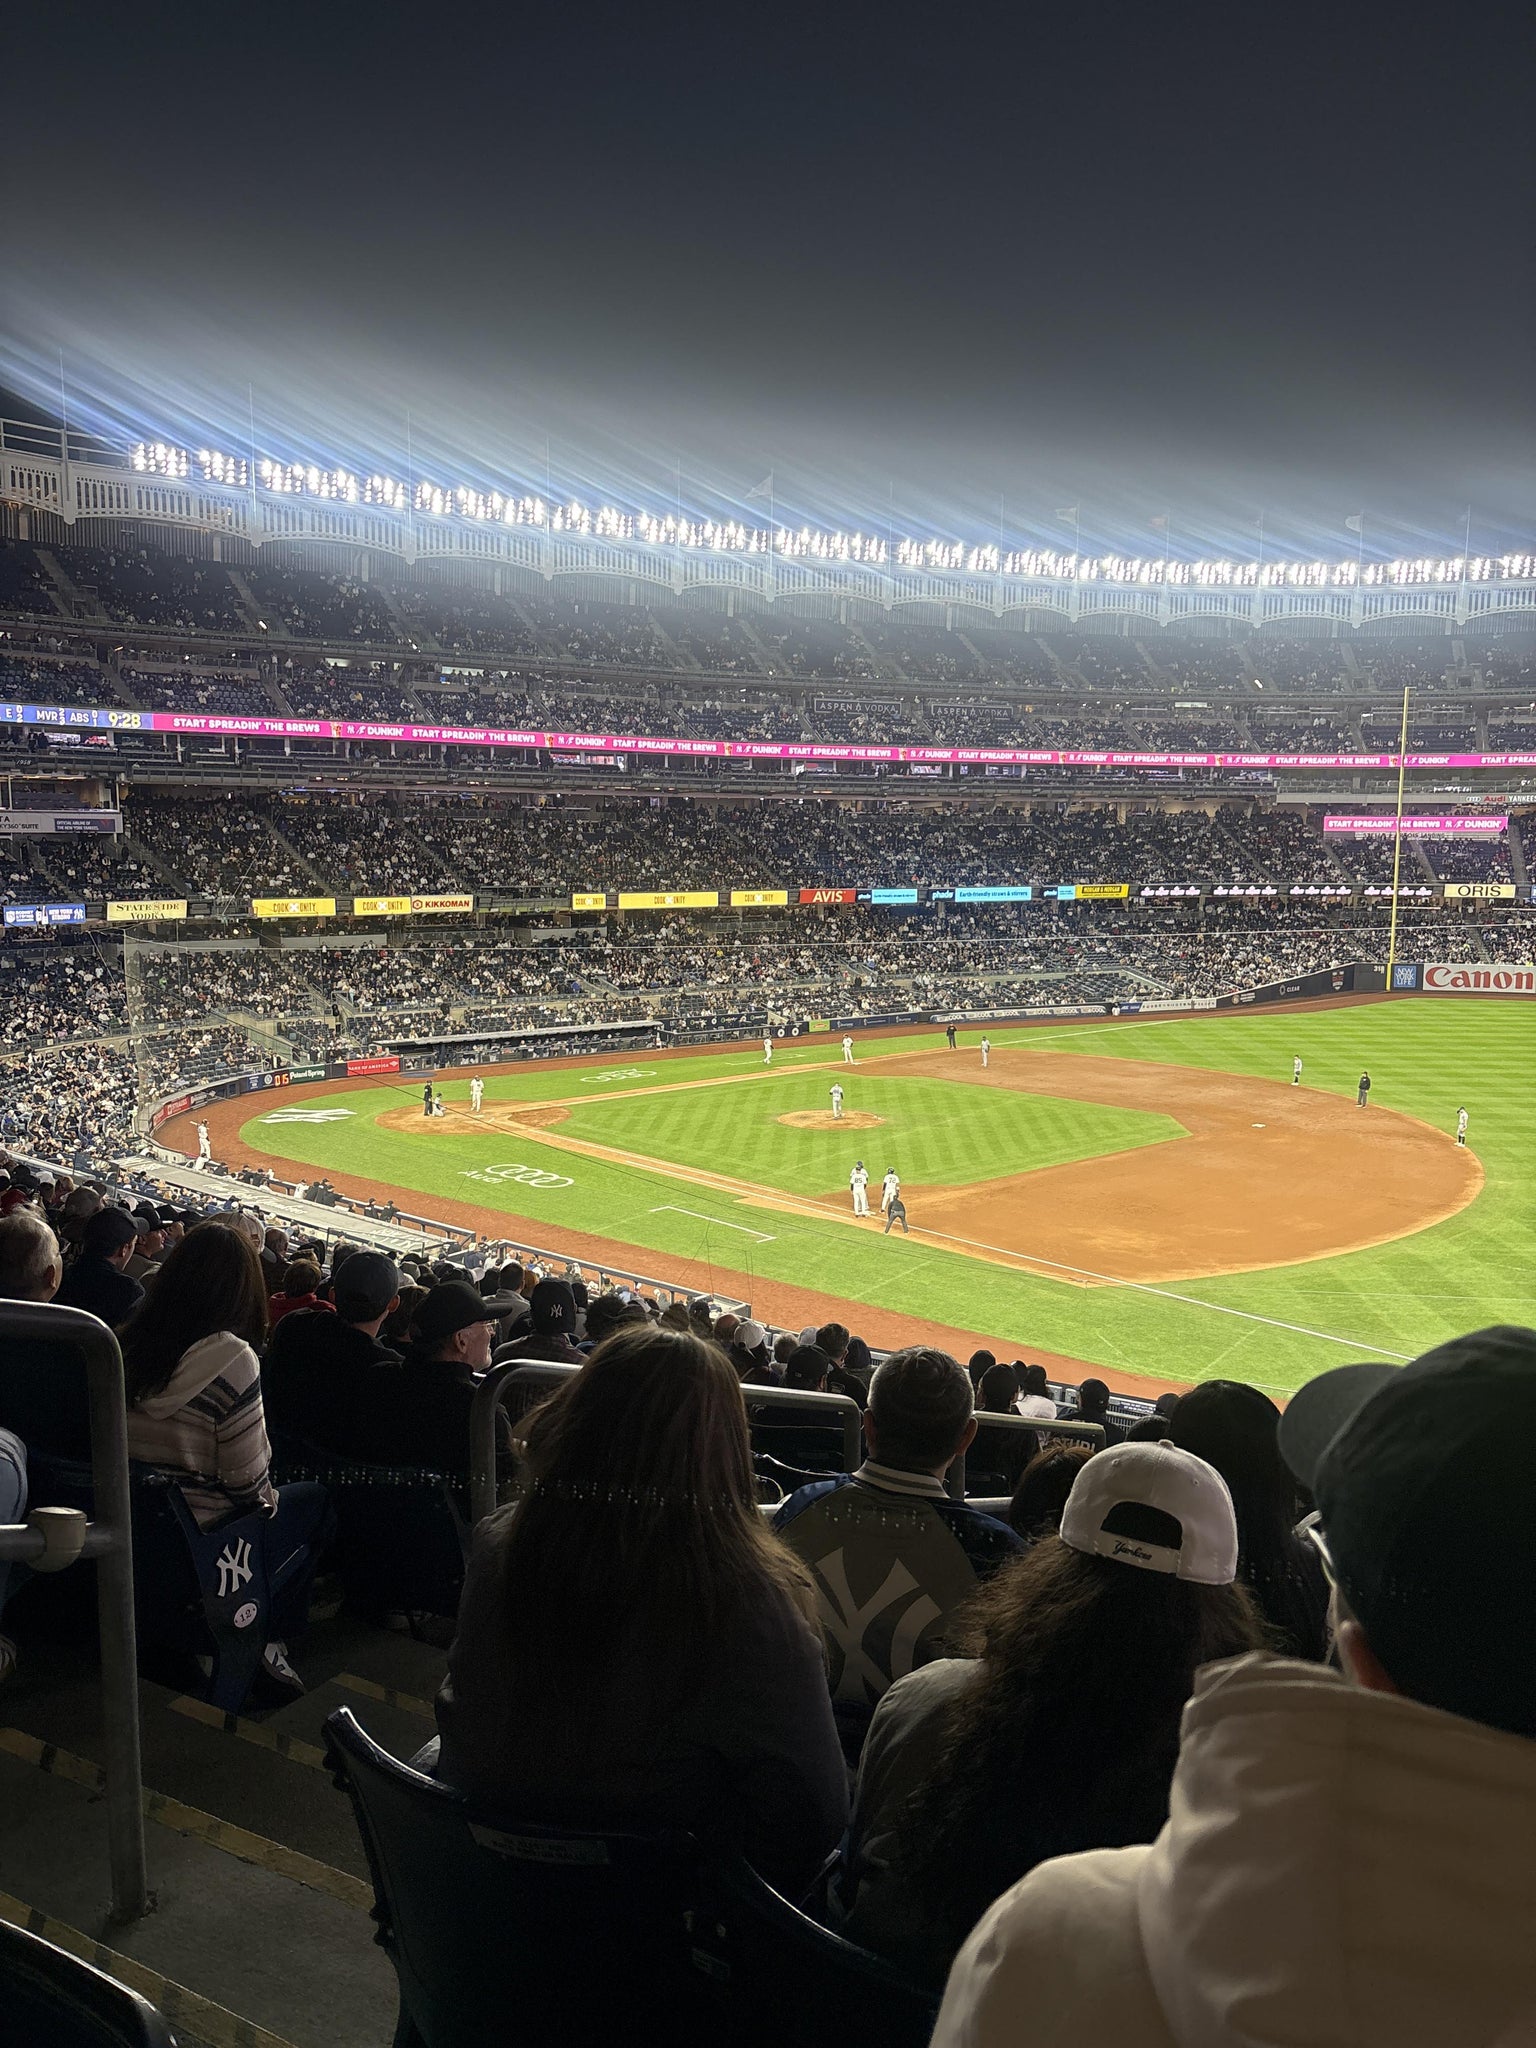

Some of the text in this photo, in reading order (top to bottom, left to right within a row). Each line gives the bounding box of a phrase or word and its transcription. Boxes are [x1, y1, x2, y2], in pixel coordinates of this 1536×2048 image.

[820, 703, 897, 713] ASPEN VODKA
[6, 708, 13, 718] E
[16, 705, 23, 714] 0
[36, 710, 58, 721] MVR
[59, 708, 65, 717] 2
[70, 712, 89, 723] ABS
[108, 712, 142, 728] 9:28
[16, 713, 23, 723] 2
[173, 718, 320, 733] START SPREADIN' THE BREWS
[367, 726, 404, 736] DUNKIN'
[412, 728, 440, 739] START
[441, 729, 486, 741] SPREADIN'
[489, 732, 505, 742] THE
[507, 733, 536, 743] BREWS
[575, 736, 606, 746] DUNKIN'
[612, 739, 636, 748] START
[637, 740, 675, 750] SPREADIN'
[677, 742, 692, 751] THE
[692, 743, 717, 752] BREWS
[752, 746, 782, 755] DUNKIN'
[788, 747, 811, 755] START
[812, 747, 850, 757] SPREADIN'
[852, 749, 866, 757] THE
[866, 749, 891, 757] BREWS
[957, 751, 979, 760] START
[979, 752, 1015, 760] SPREADIN'
[1015, 752, 1029, 760] THE
[1029, 753, 1051, 761] BREWS
[1112, 755, 1132, 763] START
[1133, 755, 1169, 763] SPREADIN'
[1184, 756, 1207, 764] BREWS
[1299, 757, 1337, 765] SPREADIN'
[1339, 757, 1354, 765] THE
[1355, 757, 1380, 765] BREWS
[1418, 756, 1450, 764] DUNKIN'
[1481, 756, 1506, 764] START
[1328, 820, 1352, 828] START
[1353, 820, 1394, 828] SPREADIN'
[1412, 820, 1440, 828] BREWS
[1464, 820, 1502, 829] DUNKIN'
[812, 890, 844, 902] AVIS
[959, 890, 991, 898] Earth-friendly
[1458, 886, 1501, 897] ORIS
[116, 902, 179, 911] STATESIDE
[273, 903, 316, 912] COOK UNITY
[362, 900, 403, 910] COOK UNITY
[425, 900, 470, 908] KIKKOMAN
[1425, 966, 1534, 990] Canon
[290, 1068, 325, 1080] Poland Spring
[239, 1609, 252, 1622] 12
